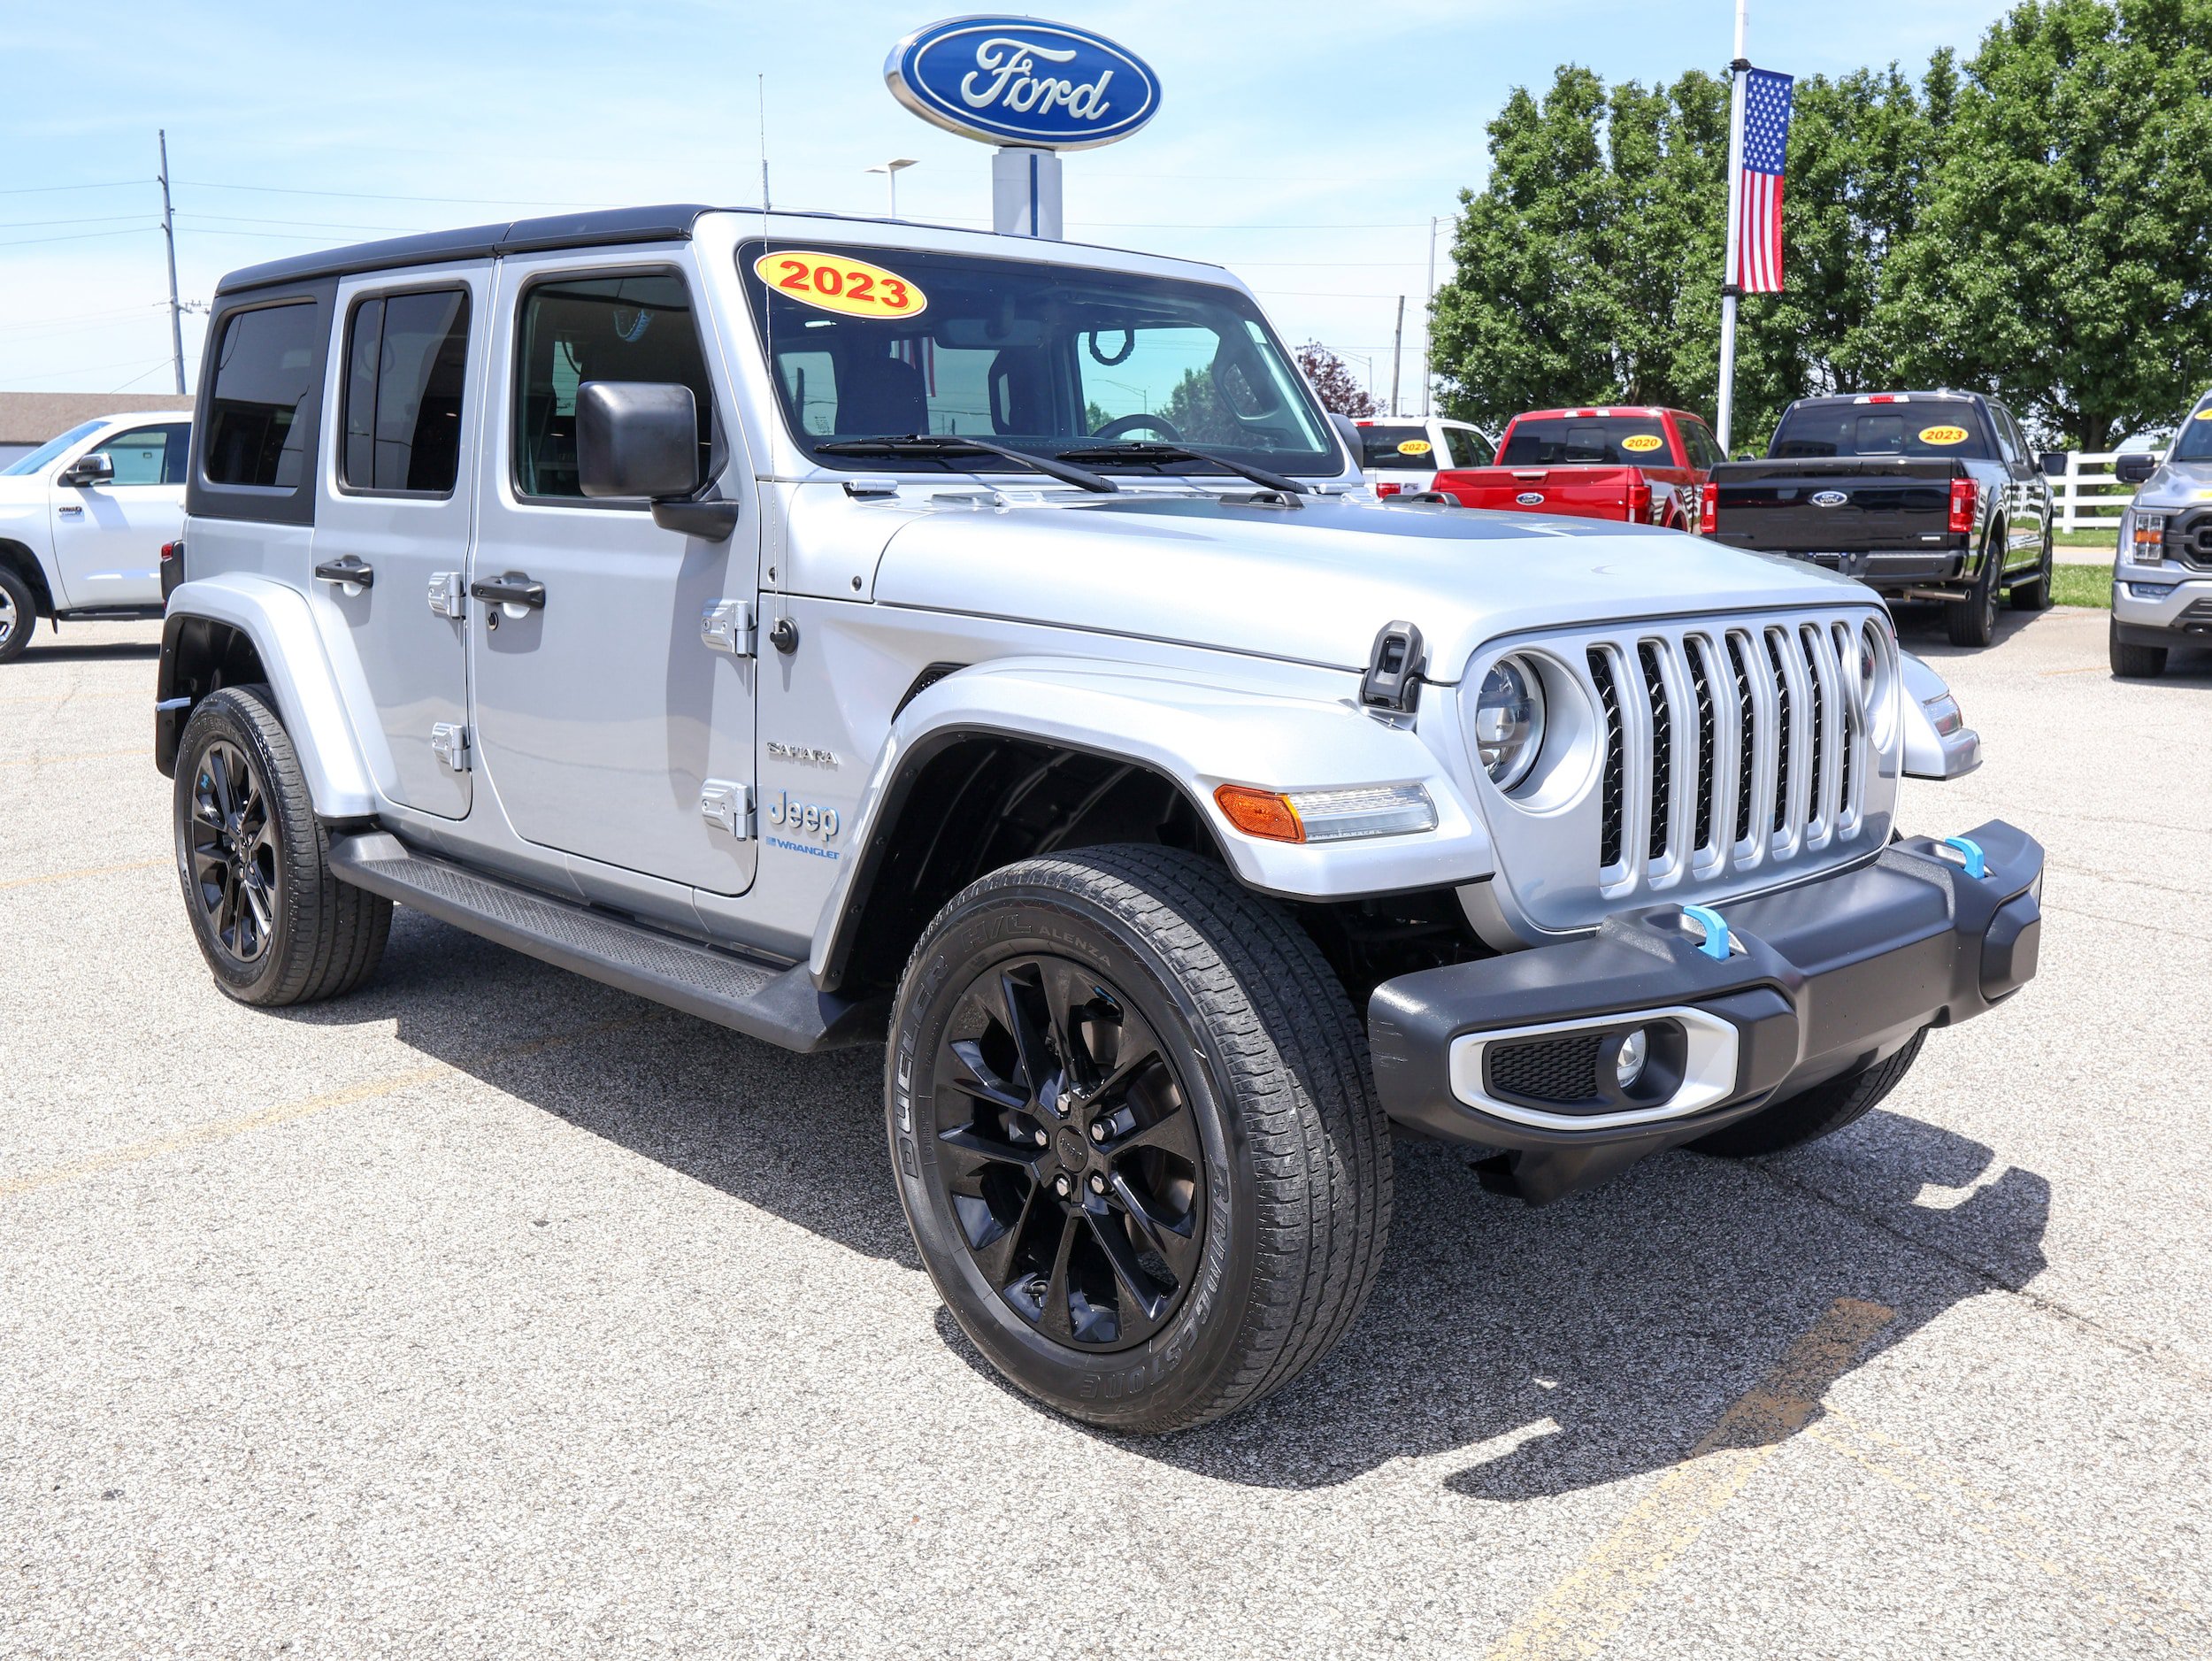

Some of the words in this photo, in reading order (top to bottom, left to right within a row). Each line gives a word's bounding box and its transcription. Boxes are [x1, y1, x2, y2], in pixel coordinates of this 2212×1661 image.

[961, 38, 1113, 120] Ford
[780, 260, 909, 309] 2023
[1627, 439, 1658, 448] 2020
[1924, 430, 1963, 441] 2023
[767, 742, 839, 765] SAHARA
[766, 789, 840, 842] Jeep
[895, 954, 949, 1179] DUELER
[1039, 926, 1112, 967] ALENZA
